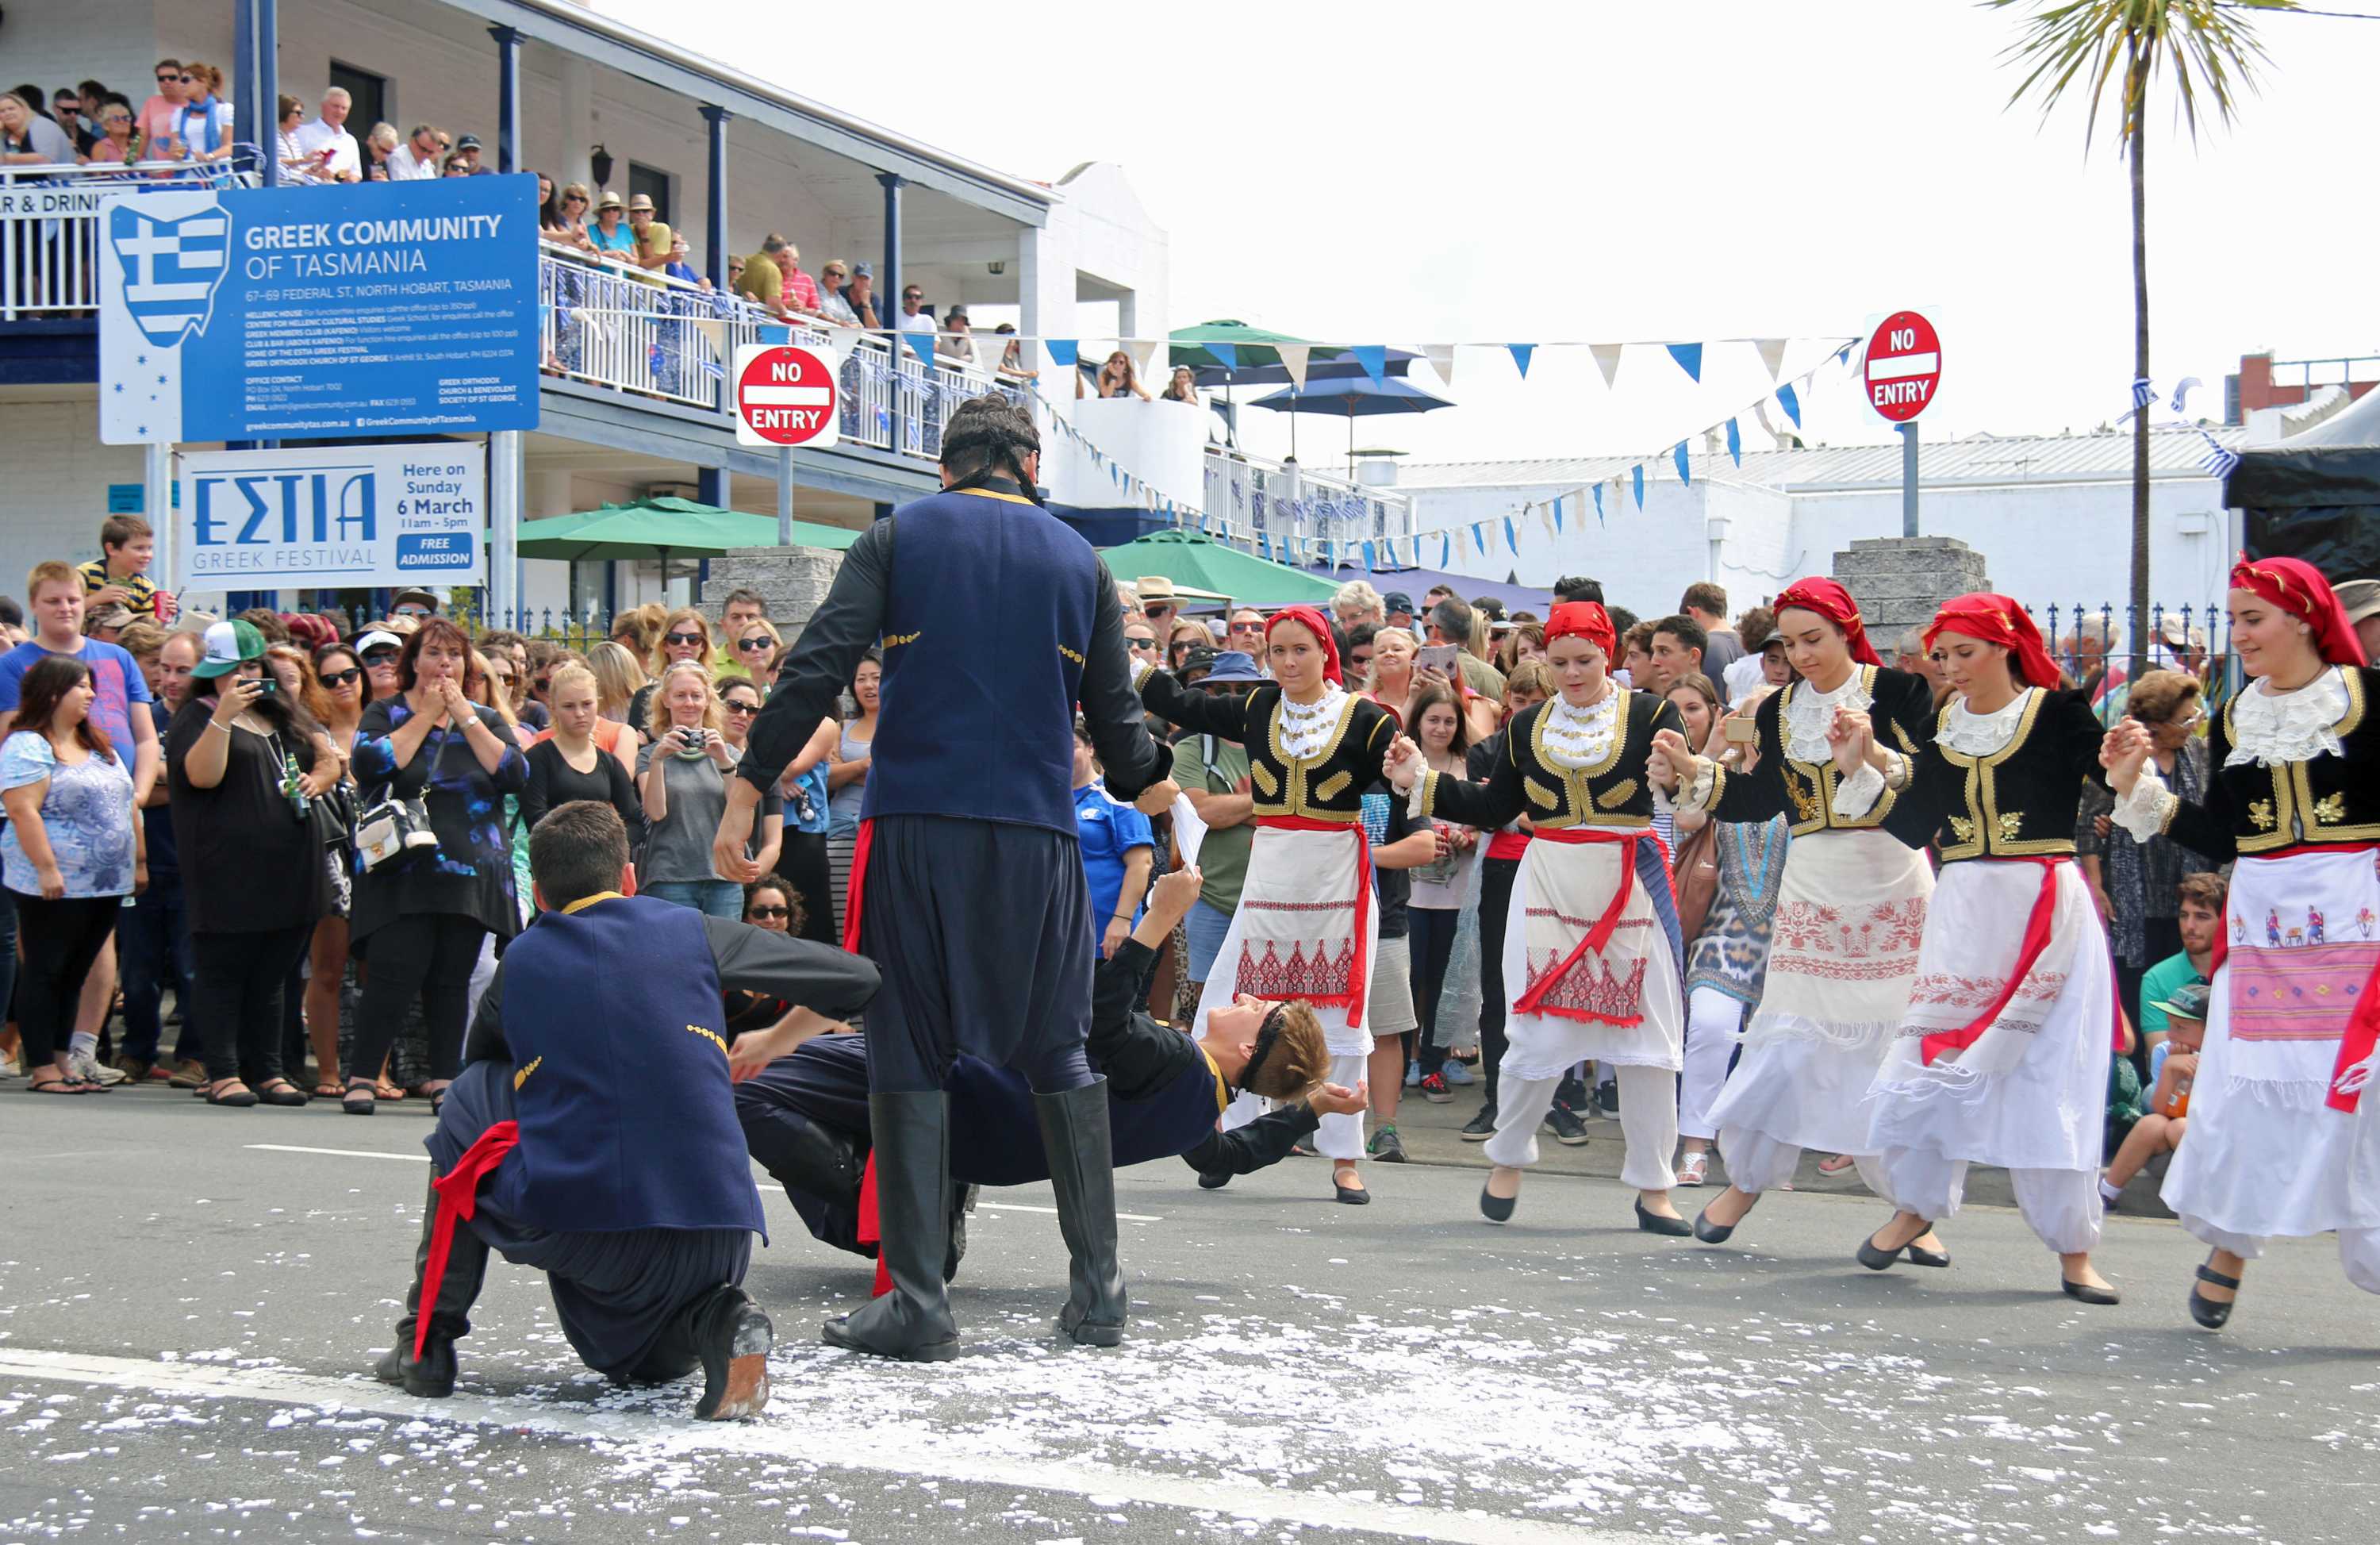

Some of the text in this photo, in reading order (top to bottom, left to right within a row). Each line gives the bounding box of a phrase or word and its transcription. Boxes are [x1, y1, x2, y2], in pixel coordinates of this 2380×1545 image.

[21, 195, 36, 213] &
[245, 214, 502, 250] GREEK COMMUNITY
[245, 248, 427, 279] OF TASMANIA
[282, 286, 334, 300] FEDERAL
[336, 286, 354, 298] ST,
[357, 283, 397, 297] NORTH
[401, 282, 451, 294] HOBART,
[452, 279, 512, 293] TASMANIA
[1891, 328, 1914, 352] NO
[771, 362, 802, 382] NO
[1874, 379, 1930, 407] ENTRY
[751, 408, 821, 429] ENTRY
[403, 463, 465, 477] Here on
[407, 481, 462, 497] Sunday
[397, 498, 473, 515] 6 March
[401, 517, 432, 528] 11am
[443, 517, 468, 530] 5pm
[420, 537, 450, 550] FREE
[194, 548, 377, 569] GREEK FESTIVAL
[399, 552, 470, 566] ADMISSION
